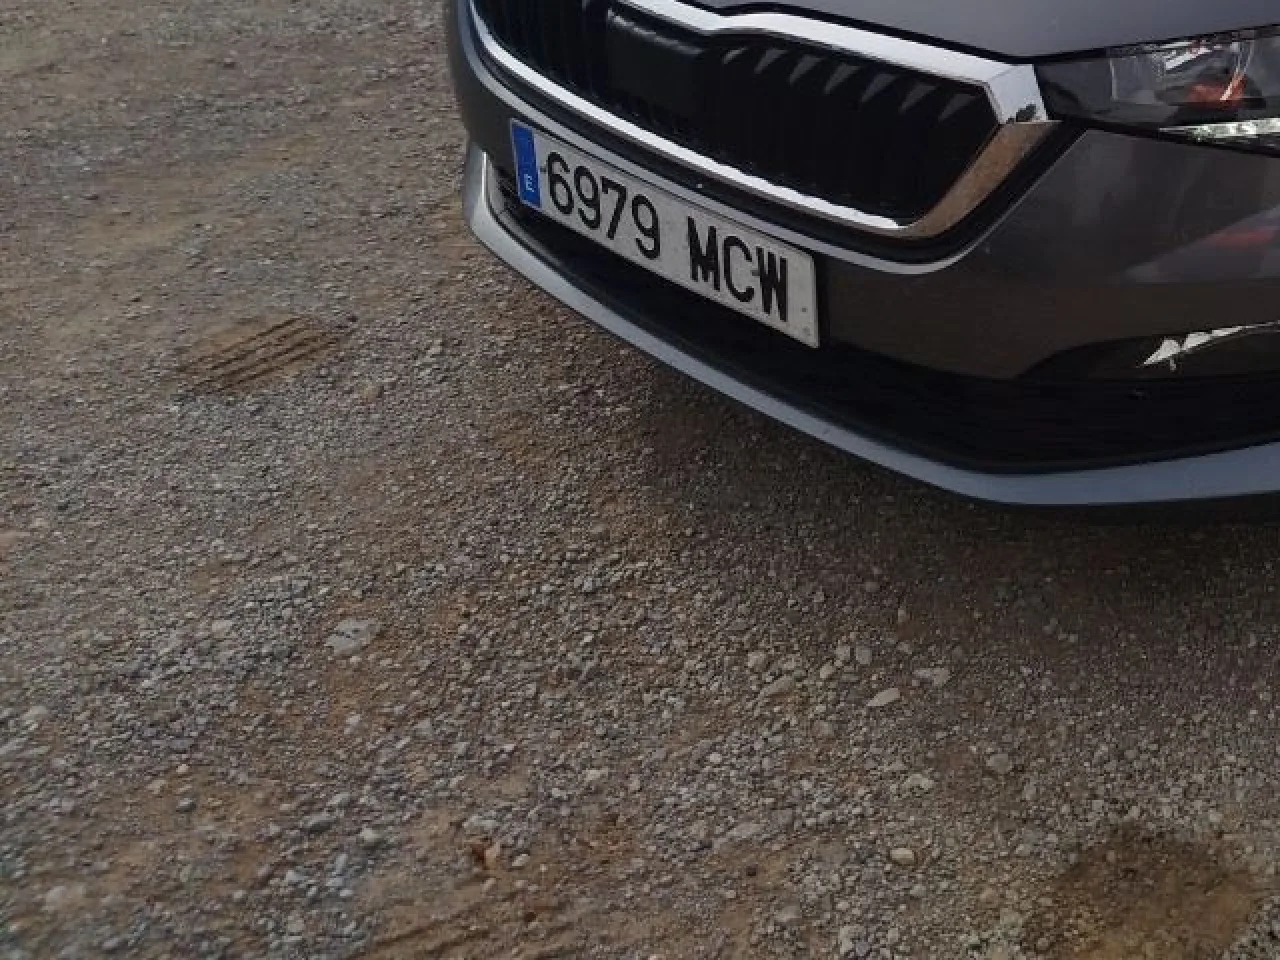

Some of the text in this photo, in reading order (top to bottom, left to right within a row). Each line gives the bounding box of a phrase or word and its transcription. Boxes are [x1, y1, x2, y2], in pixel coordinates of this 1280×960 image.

[523, 173, 534, 193] E
[546, 151, 788, 323] 6979 MCW
